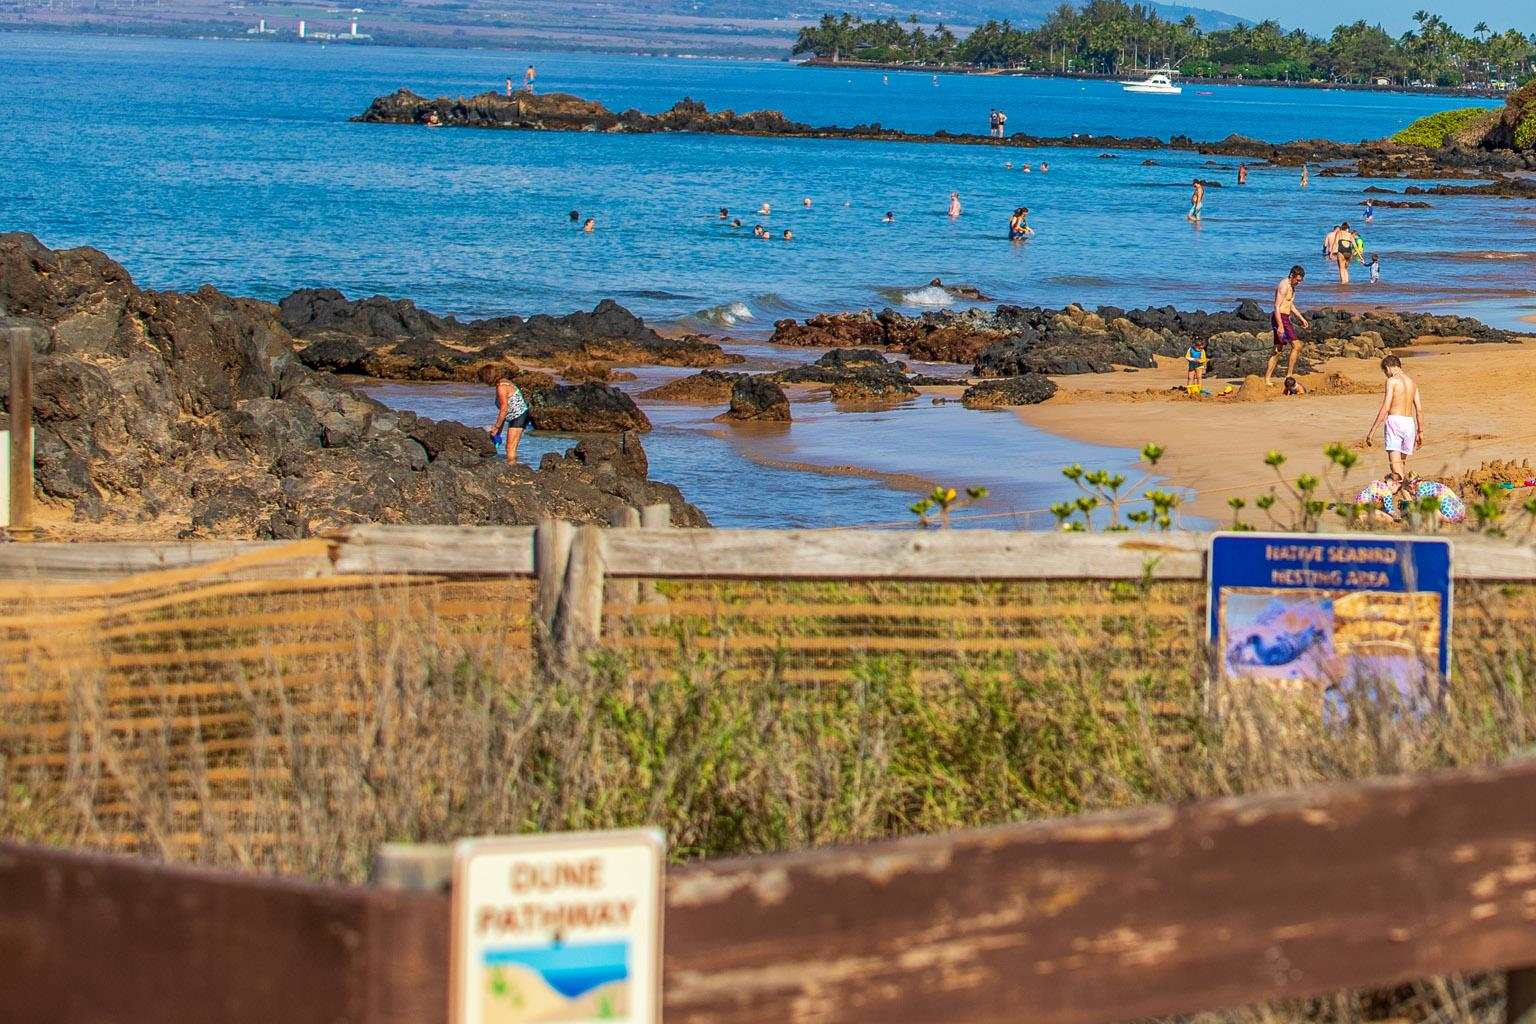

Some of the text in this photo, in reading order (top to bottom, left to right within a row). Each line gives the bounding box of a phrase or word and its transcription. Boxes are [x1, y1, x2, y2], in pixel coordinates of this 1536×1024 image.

[1265, 544, 1324, 562] NATIVE
[1271, 569, 1390, 587] NESTING AREA
[510, 858, 603, 894] DUNE
[477, 898, 636, 934] PATHWAY
